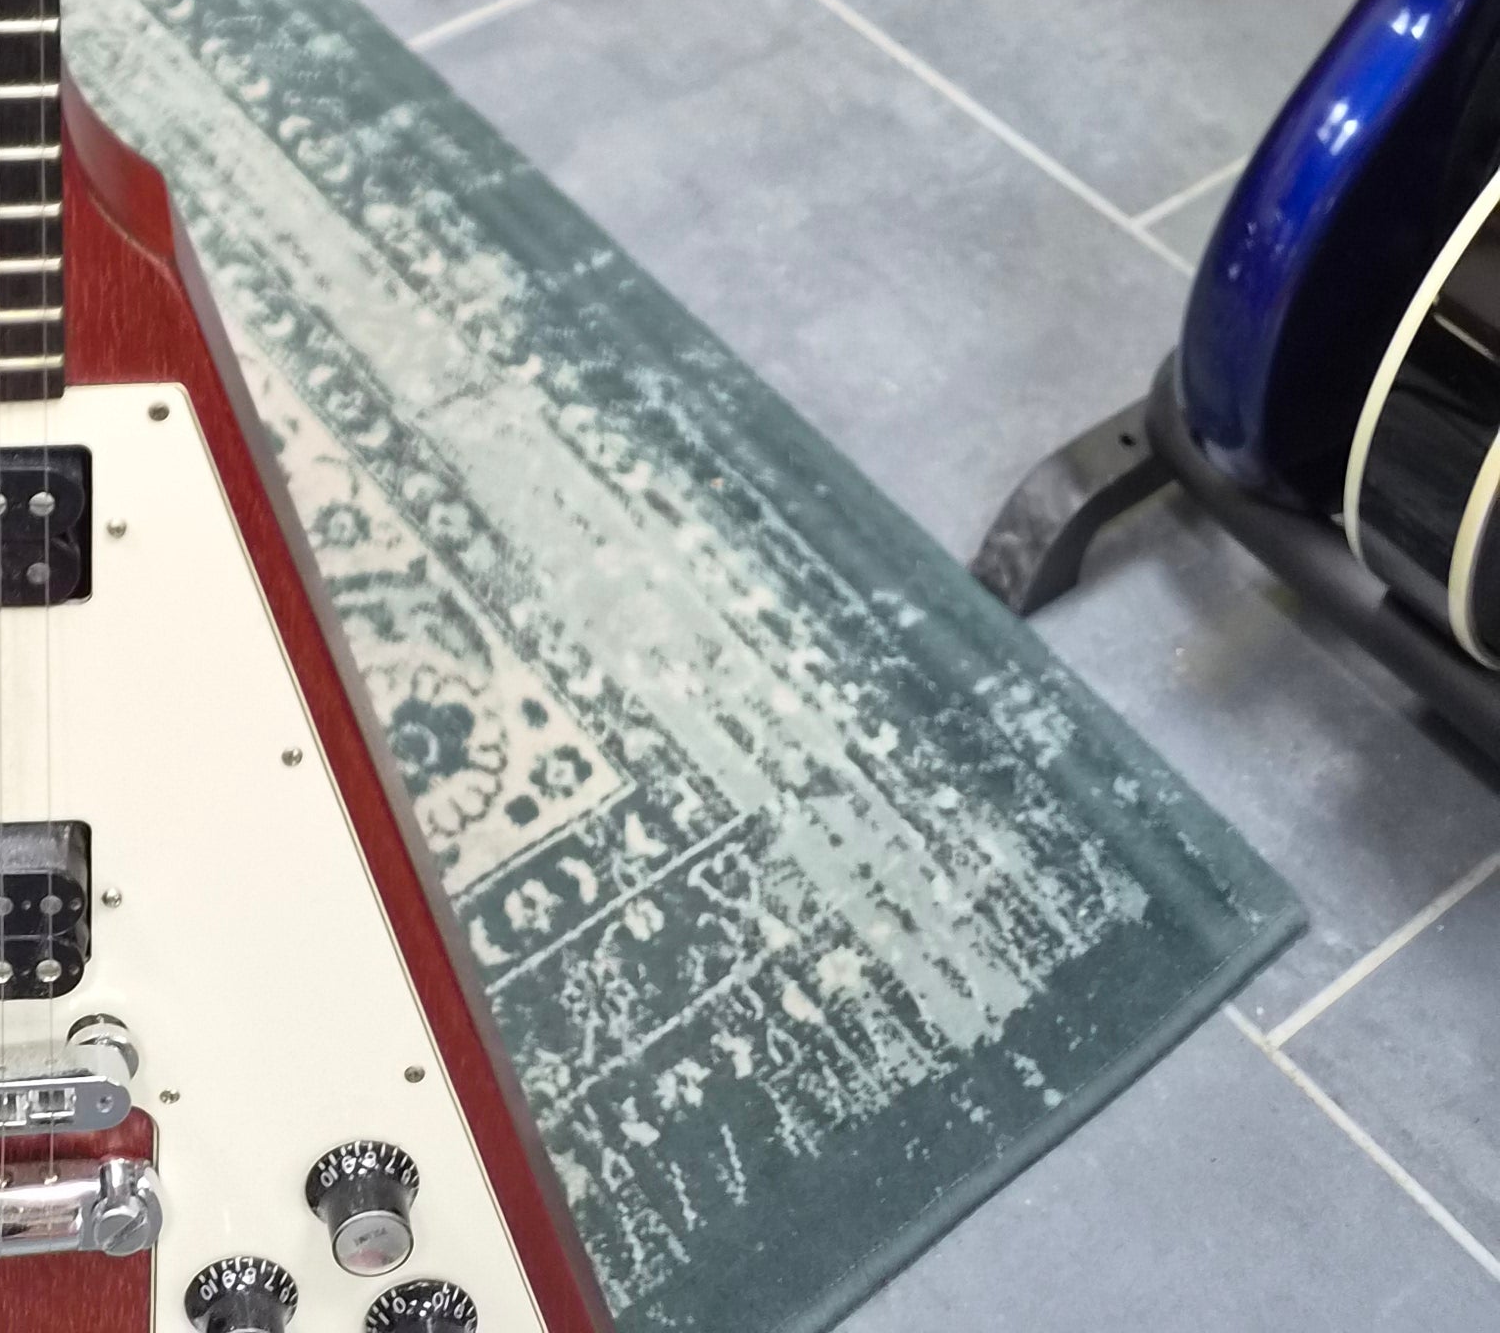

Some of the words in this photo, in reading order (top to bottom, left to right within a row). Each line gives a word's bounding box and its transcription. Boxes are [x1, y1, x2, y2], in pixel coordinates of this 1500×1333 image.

[320, 1165, 339, 1188] 10
[200, 1279, 219, 1301] 10
[432, 1292, 450, 1312] 10
